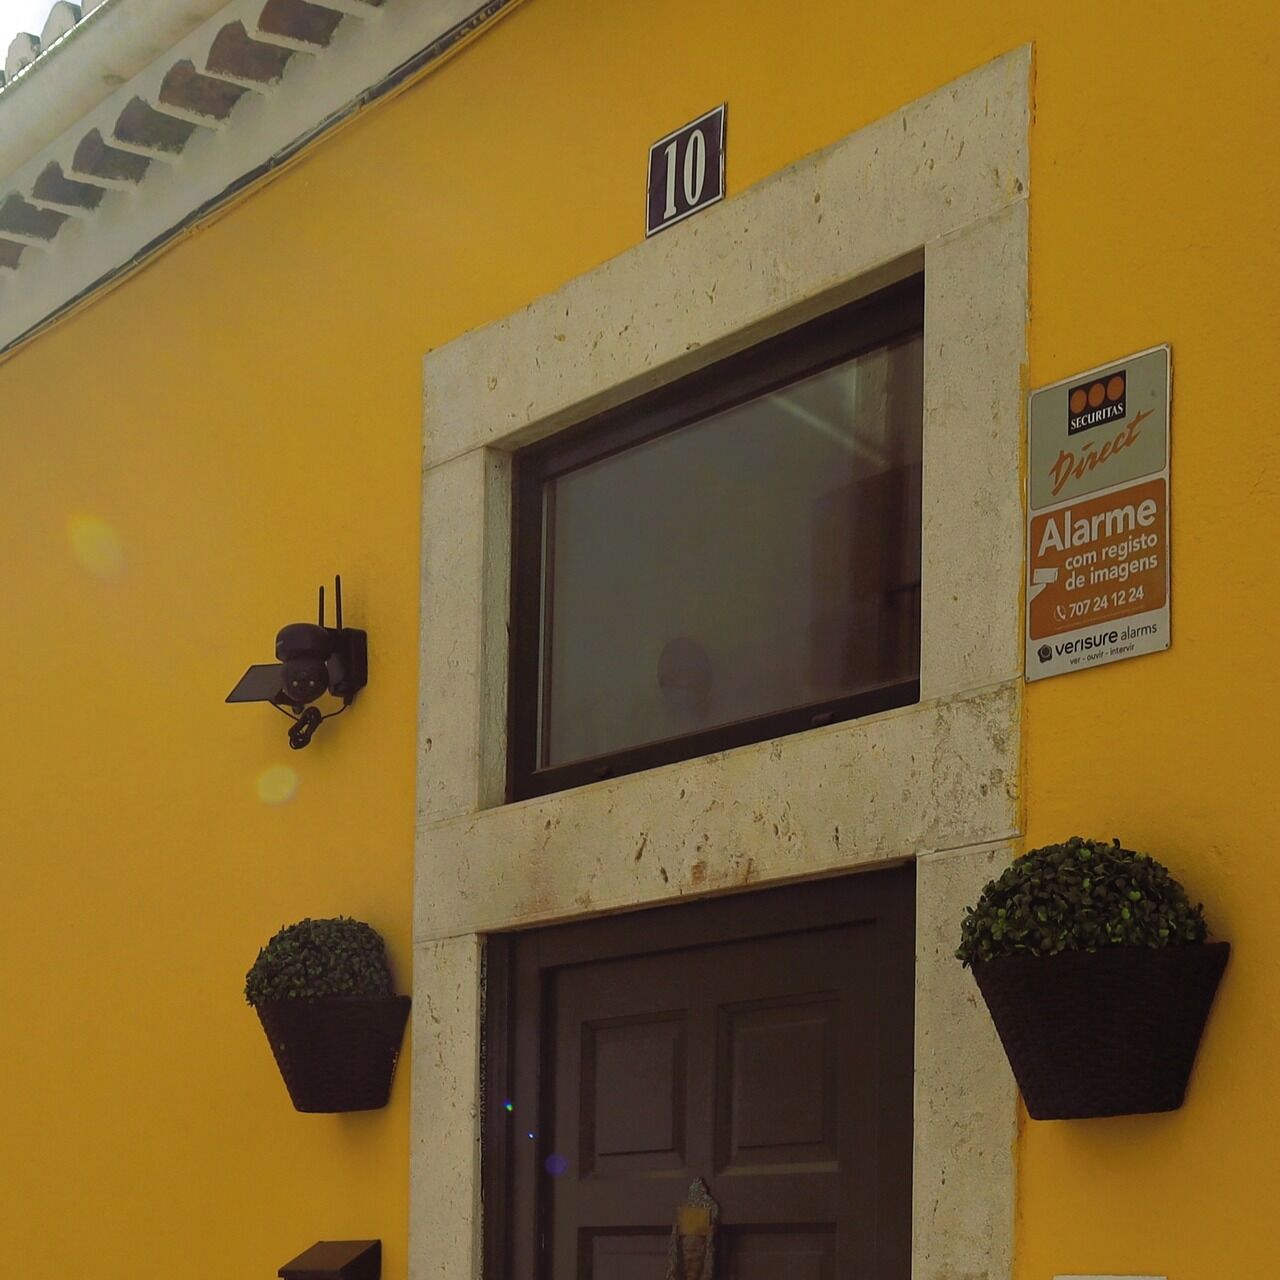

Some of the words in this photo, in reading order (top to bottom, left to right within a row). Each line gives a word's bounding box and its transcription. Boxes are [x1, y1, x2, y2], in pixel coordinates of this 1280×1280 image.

[663, 129, 706, 220] 10
[1070, 402, 1124, 430] SECURITAS
[1049, 408, 1156, 496] Direct
[1038, 499, 1157, 557] Alarme
[1065, 550, 1097, 571] com
[1102, 534, 1158, 561] registo
[1065, 572, 1086, 591] de
[1090, 554, 1158, 582] imagens
[1069, 600, 1091, 618] 707
[1093, 595, 1108, 612] 24
[1111, 590, 1126, 606] 12
[1128, 585, 1144, 602] 24
[1055, 631, 1119, 656] verisure
[1120, 623, 1157, 641] alarms
[1069, 656, 1081, 665] ver
[1086, 649, 1104, 662] ouvir
[1109, 643, 1135, 656] intervir
